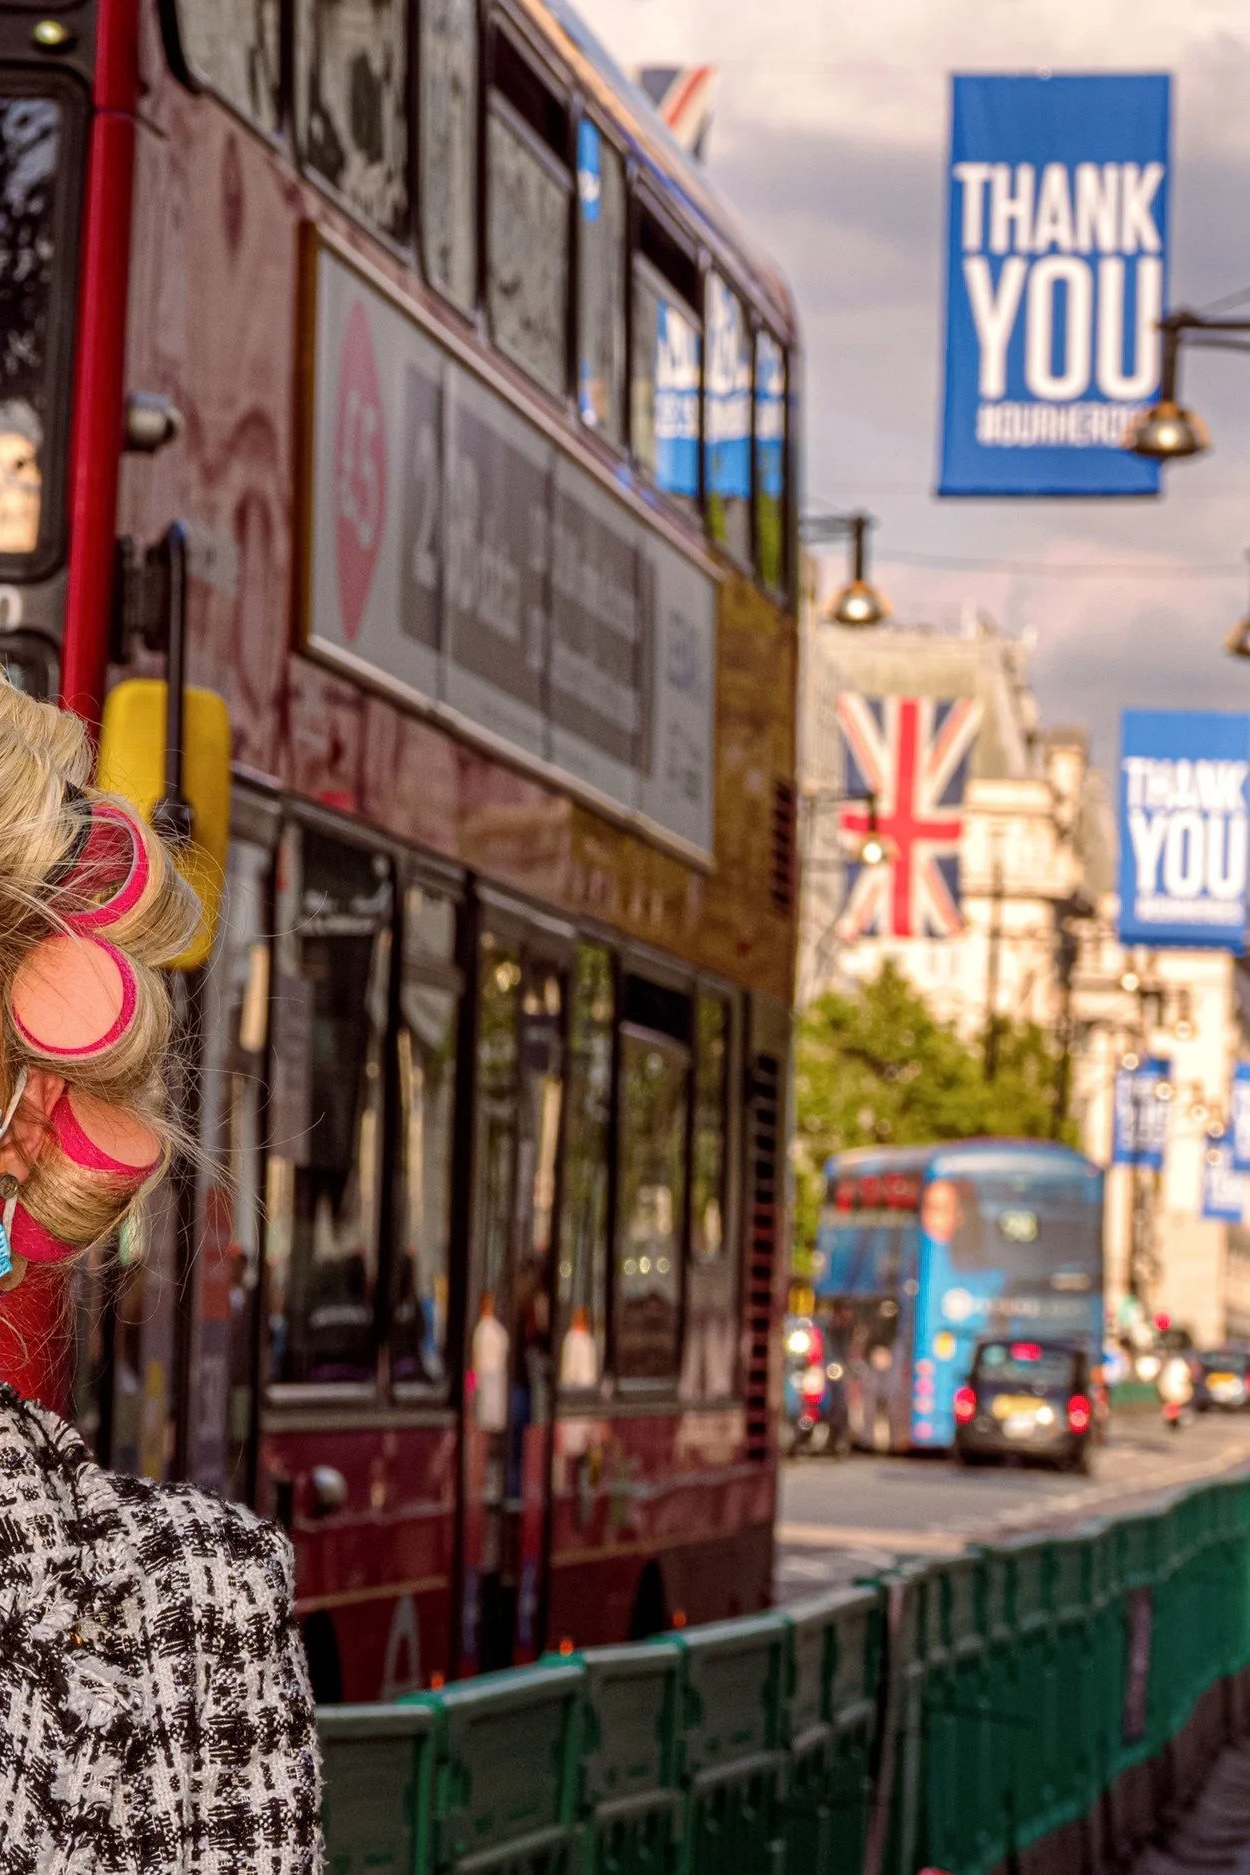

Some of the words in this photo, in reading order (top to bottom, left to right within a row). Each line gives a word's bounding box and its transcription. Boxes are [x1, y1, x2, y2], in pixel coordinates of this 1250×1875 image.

[953, 161, 1164, 255] THANK
[962, 255, 1163, 400] YOU
[1123, 756, 1248, 811] THANK
[1129, 806, 1247, 900] YOU
